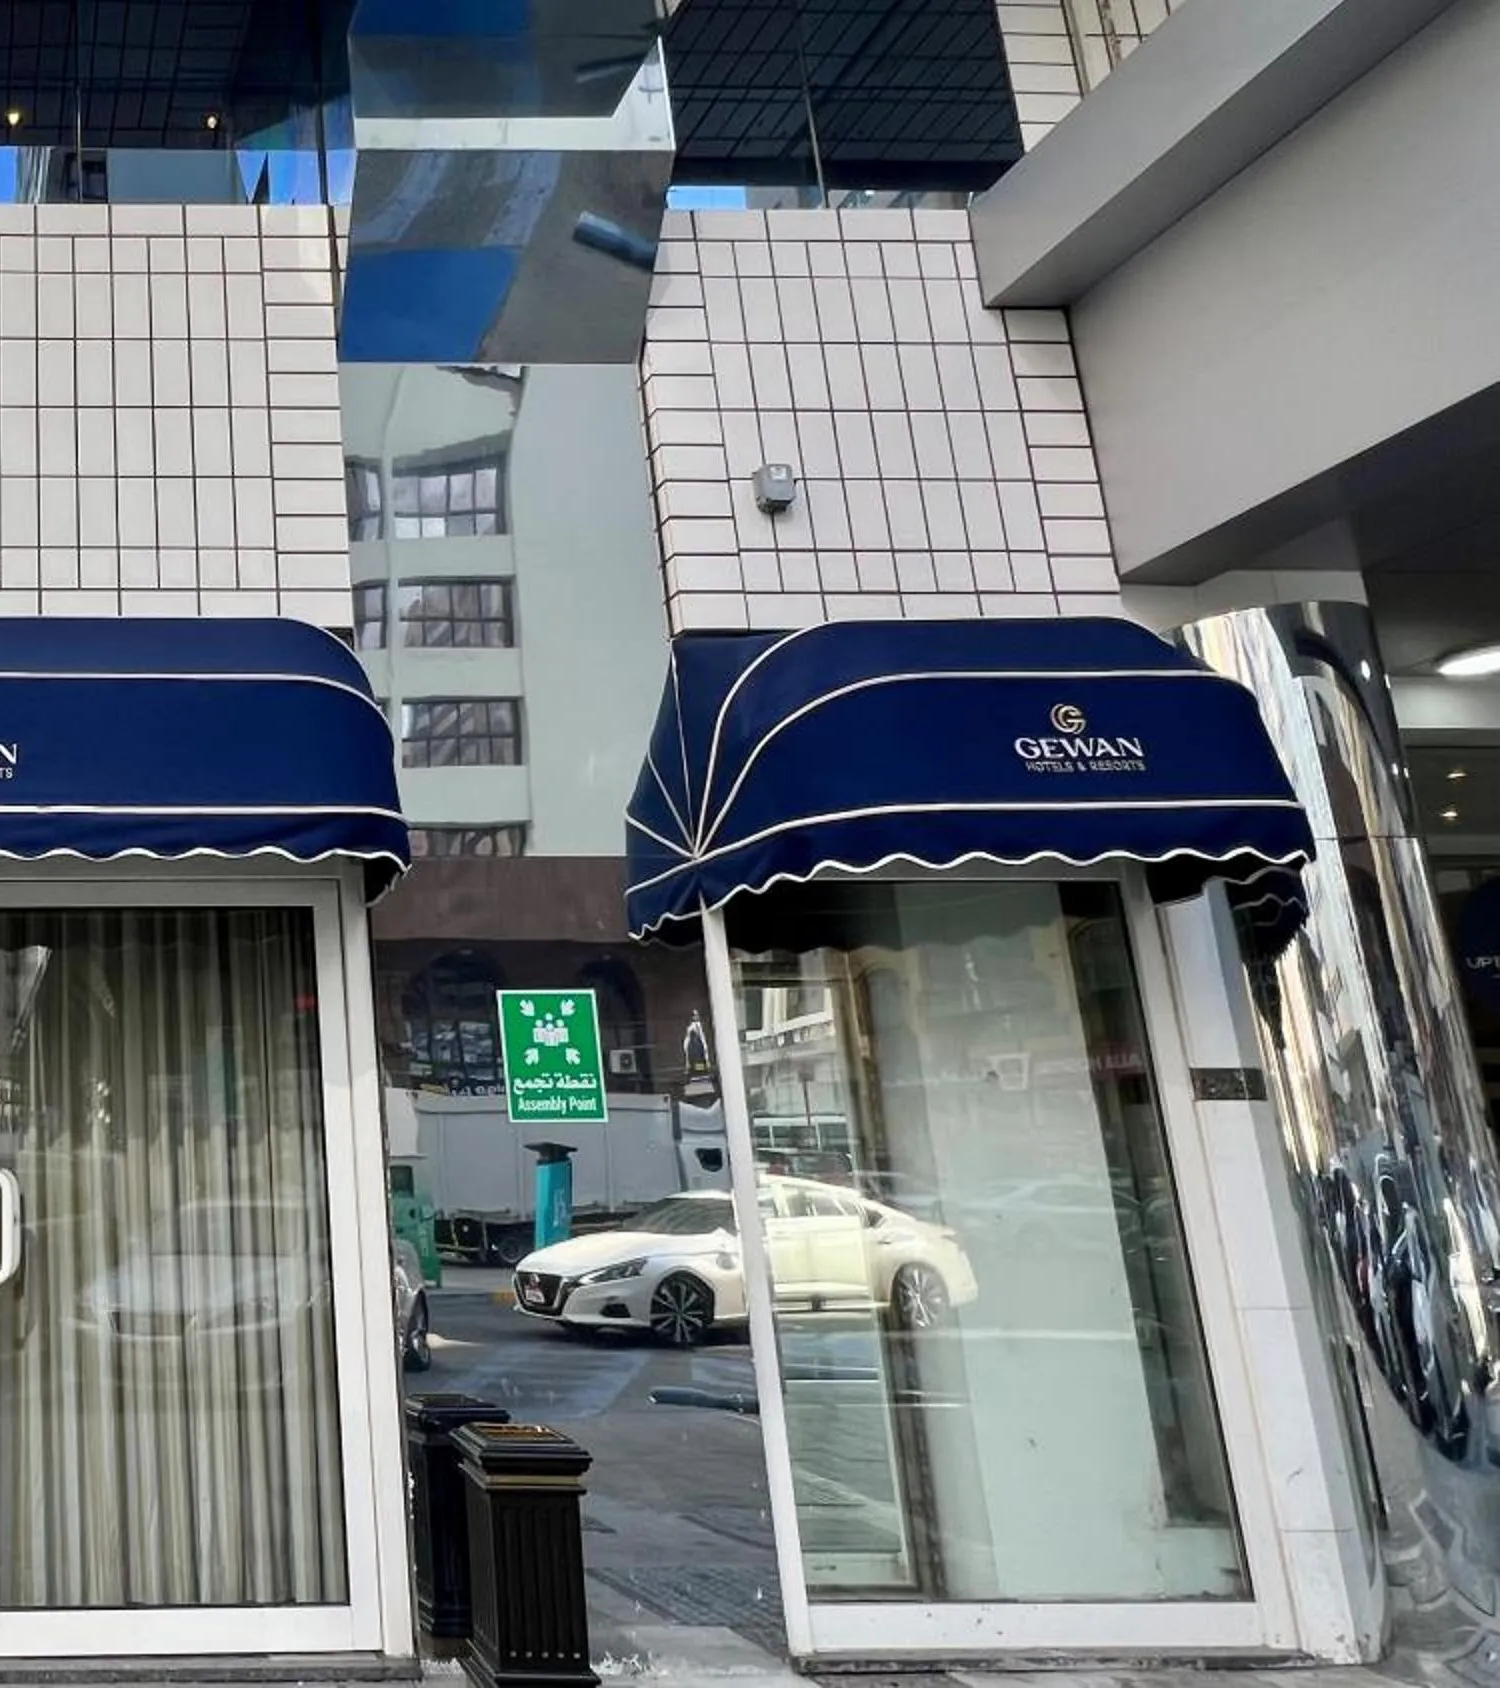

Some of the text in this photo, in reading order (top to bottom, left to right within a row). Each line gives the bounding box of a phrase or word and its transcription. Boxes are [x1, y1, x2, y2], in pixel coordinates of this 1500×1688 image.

[1014, 737, 1145, 760] GEWAN
[1025, 760, 1074, 773] HOTELS
[1089, 760, 1146, 773] RESORTS
[513, 1072, 554, 1095] تجمع
[556, 1072, 597, 1089] نقطة
[518, 1095, 597, 1116] Assembly Point
